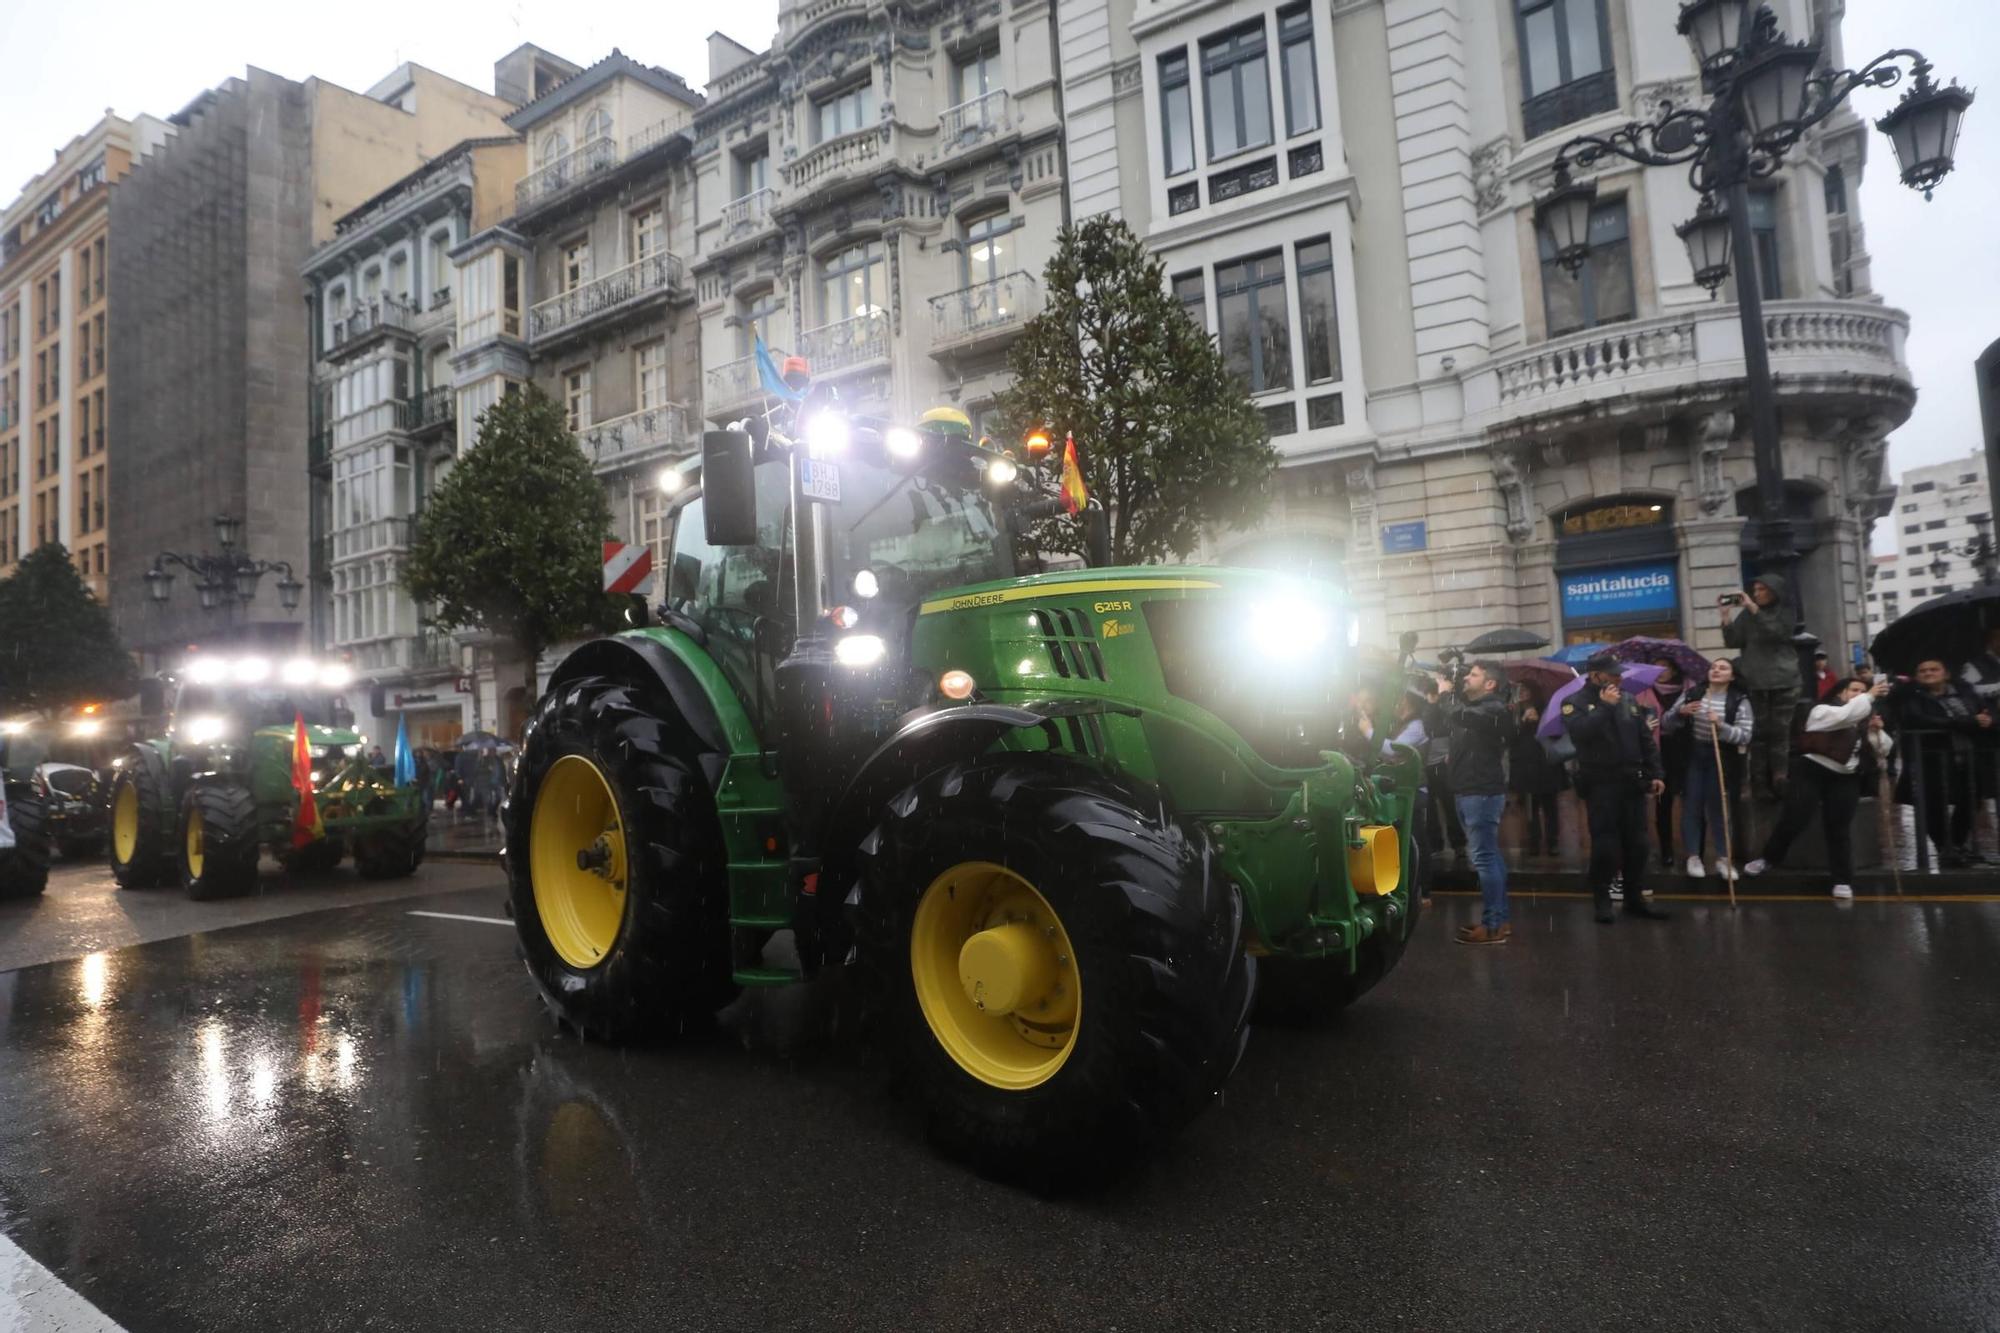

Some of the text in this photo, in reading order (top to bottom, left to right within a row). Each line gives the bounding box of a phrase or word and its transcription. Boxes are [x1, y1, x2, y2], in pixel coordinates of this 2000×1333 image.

[1567, 572, 1670, 596] santalucía
[951, 594, 1004, 609] JOHN DEERE
